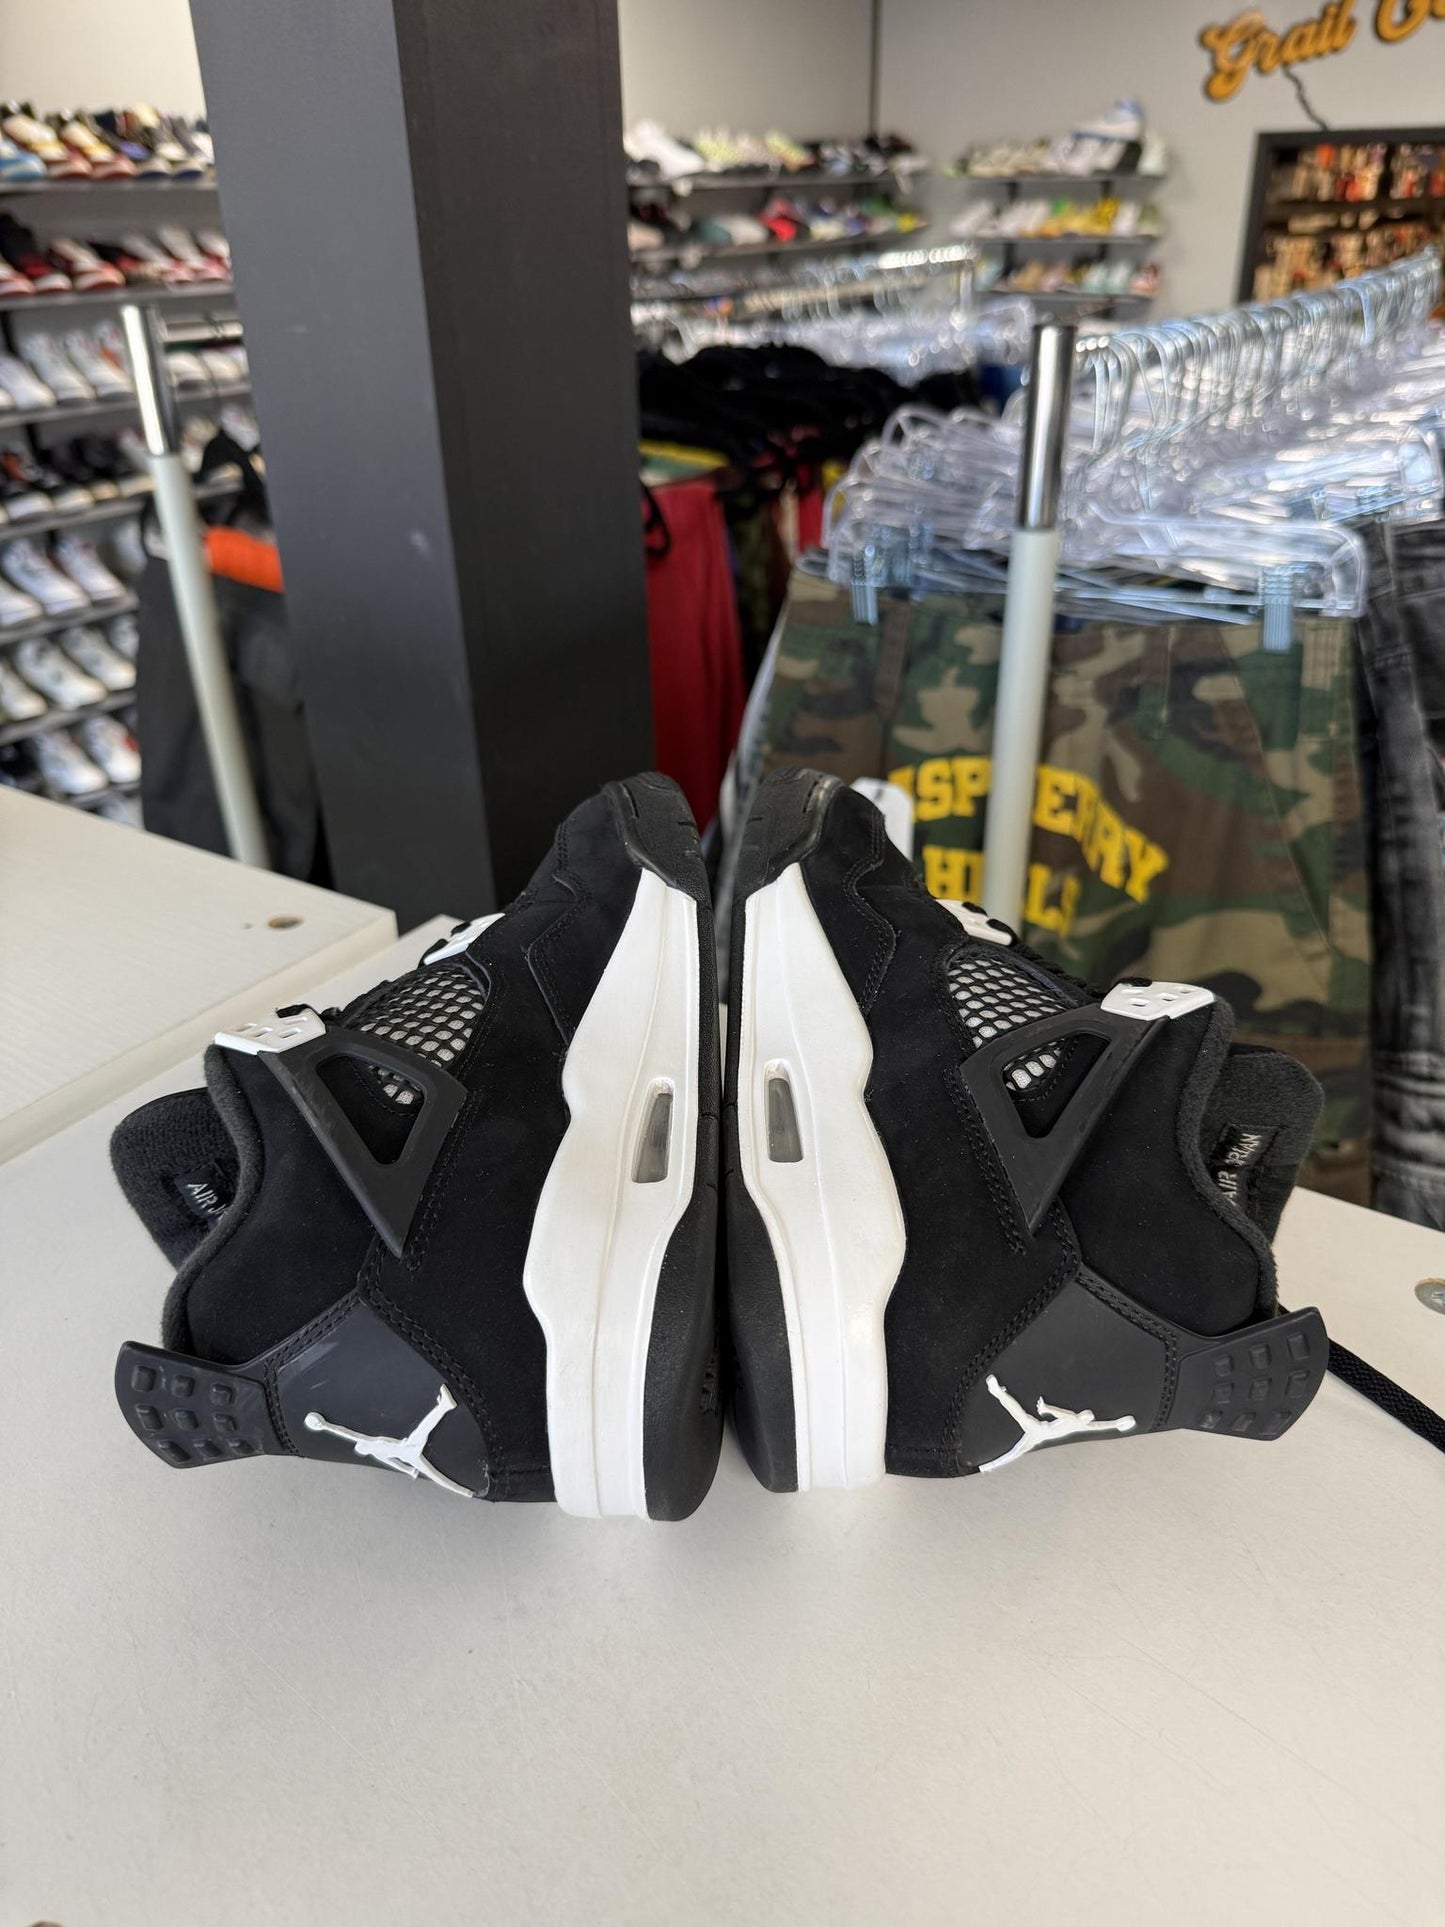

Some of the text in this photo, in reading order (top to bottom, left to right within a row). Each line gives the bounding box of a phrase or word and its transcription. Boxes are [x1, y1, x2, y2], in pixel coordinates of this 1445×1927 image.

[1199, 0, 1357, 101] Grail
[888, 756, 1168, 903] SPERY
[923, 844, 1080, 937] HIL
[186, 1183, 218, 1209] AIR
[1218, 1170, 1238, 1206] AIR
